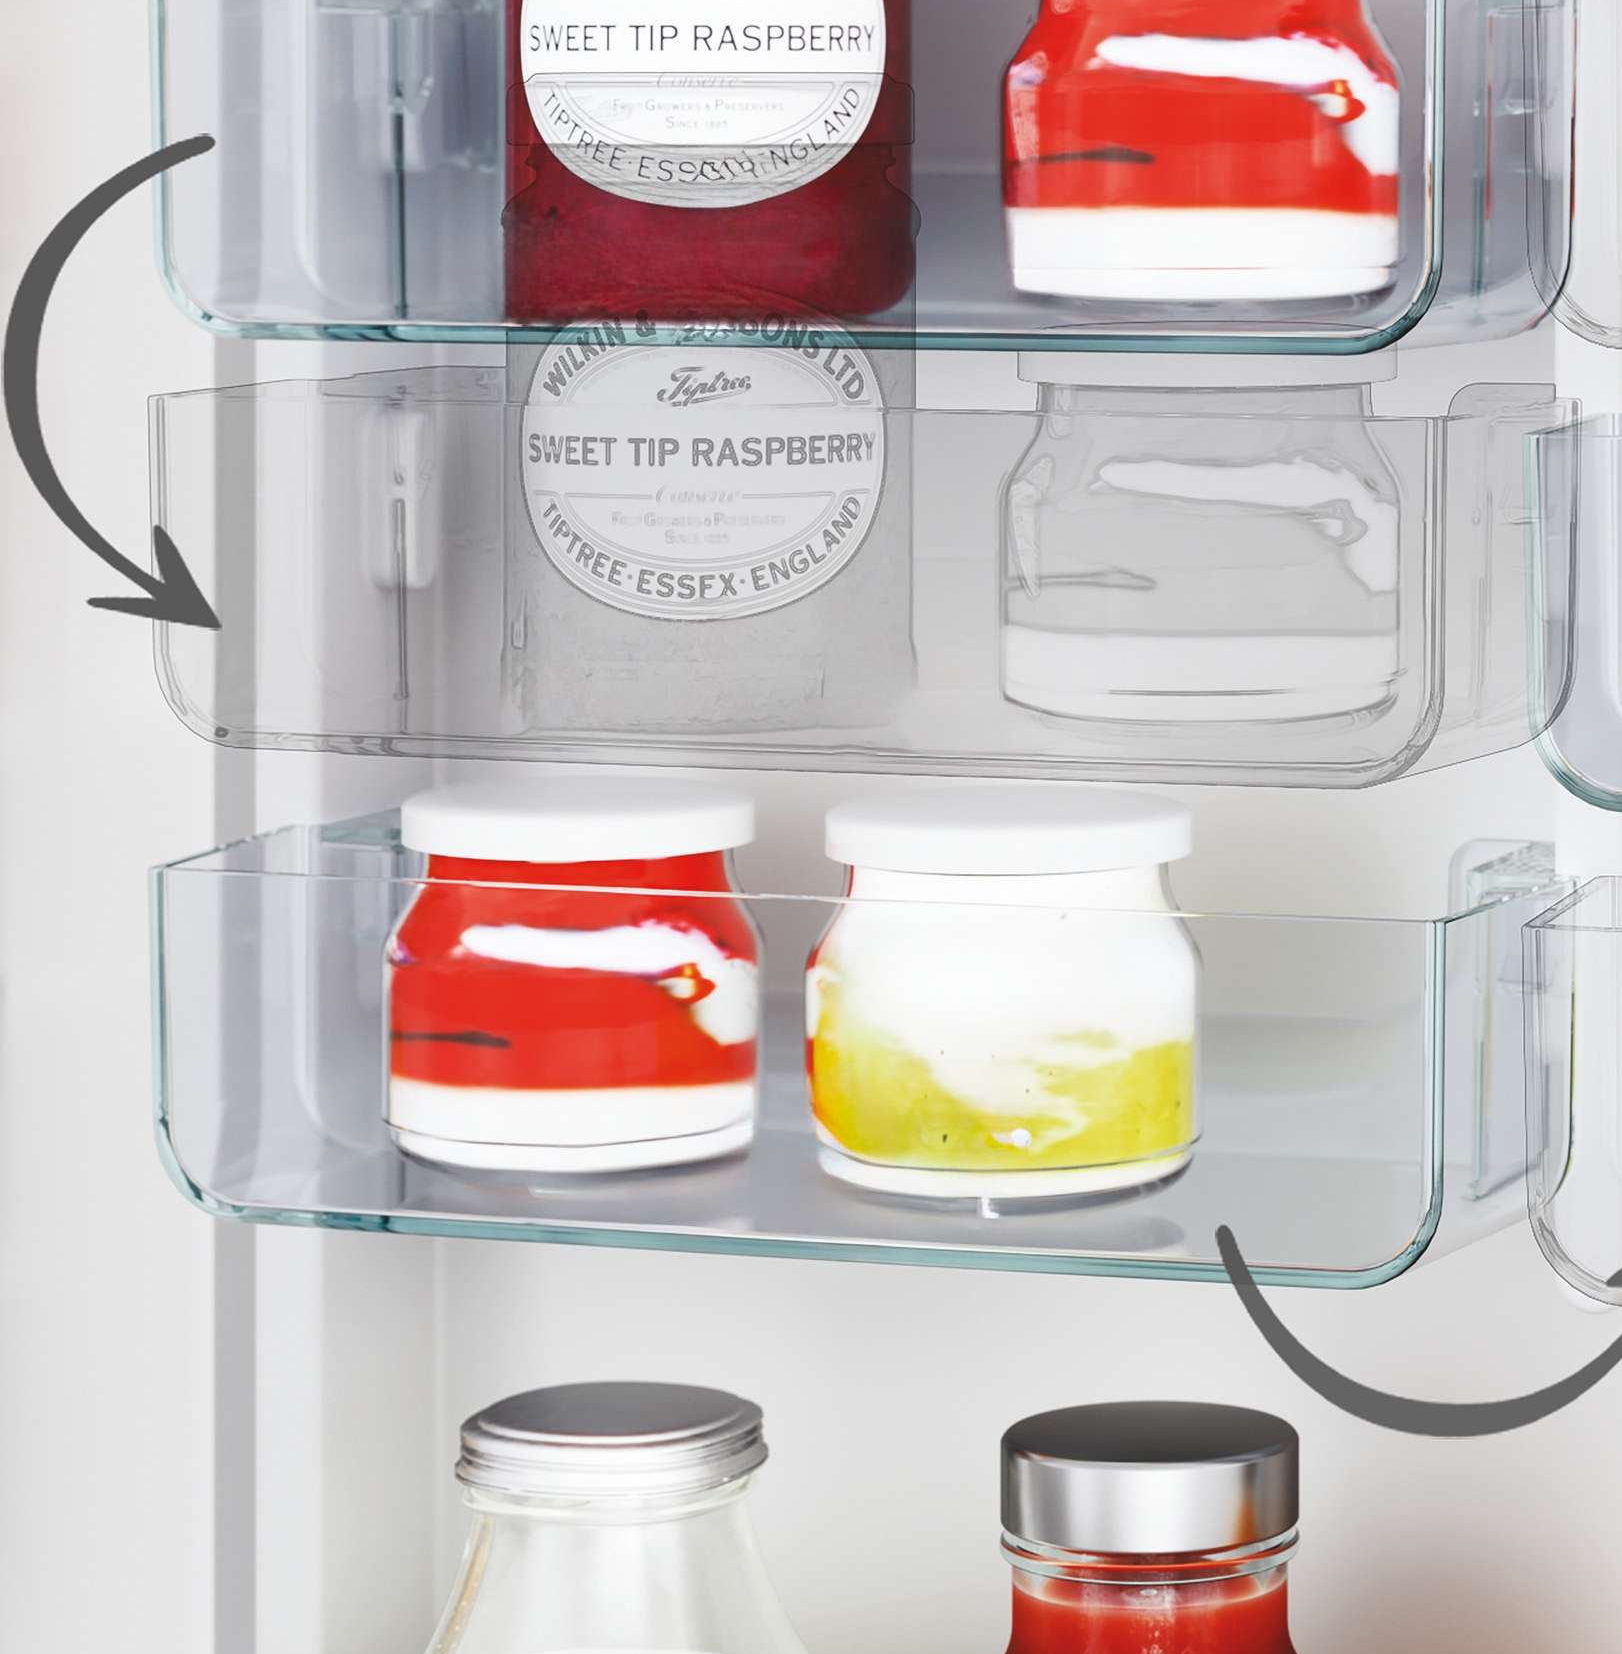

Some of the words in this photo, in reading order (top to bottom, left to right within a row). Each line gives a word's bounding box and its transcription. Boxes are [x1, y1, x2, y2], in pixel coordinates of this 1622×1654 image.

[529, 24, 617, 53] SWEET
[628, 24, 679, 52] TIP
[693, 24, 876, 53] RASPBERRY
[543, 88, 627, 172] TIPTREE
[752, 87, 861, 177] NGLAND
[543, 315, 627, 398] WILKIN
[823, 345, 865, 400] LTD
[528, 432, 618, 466] SWEET
[628, 437, 680, 467] TIP
[692, 432, 877, 467] RASPBERRY
[543, 498, 628, 587] TIPTREE
[750, 495, 862, 592] ENGLAND
